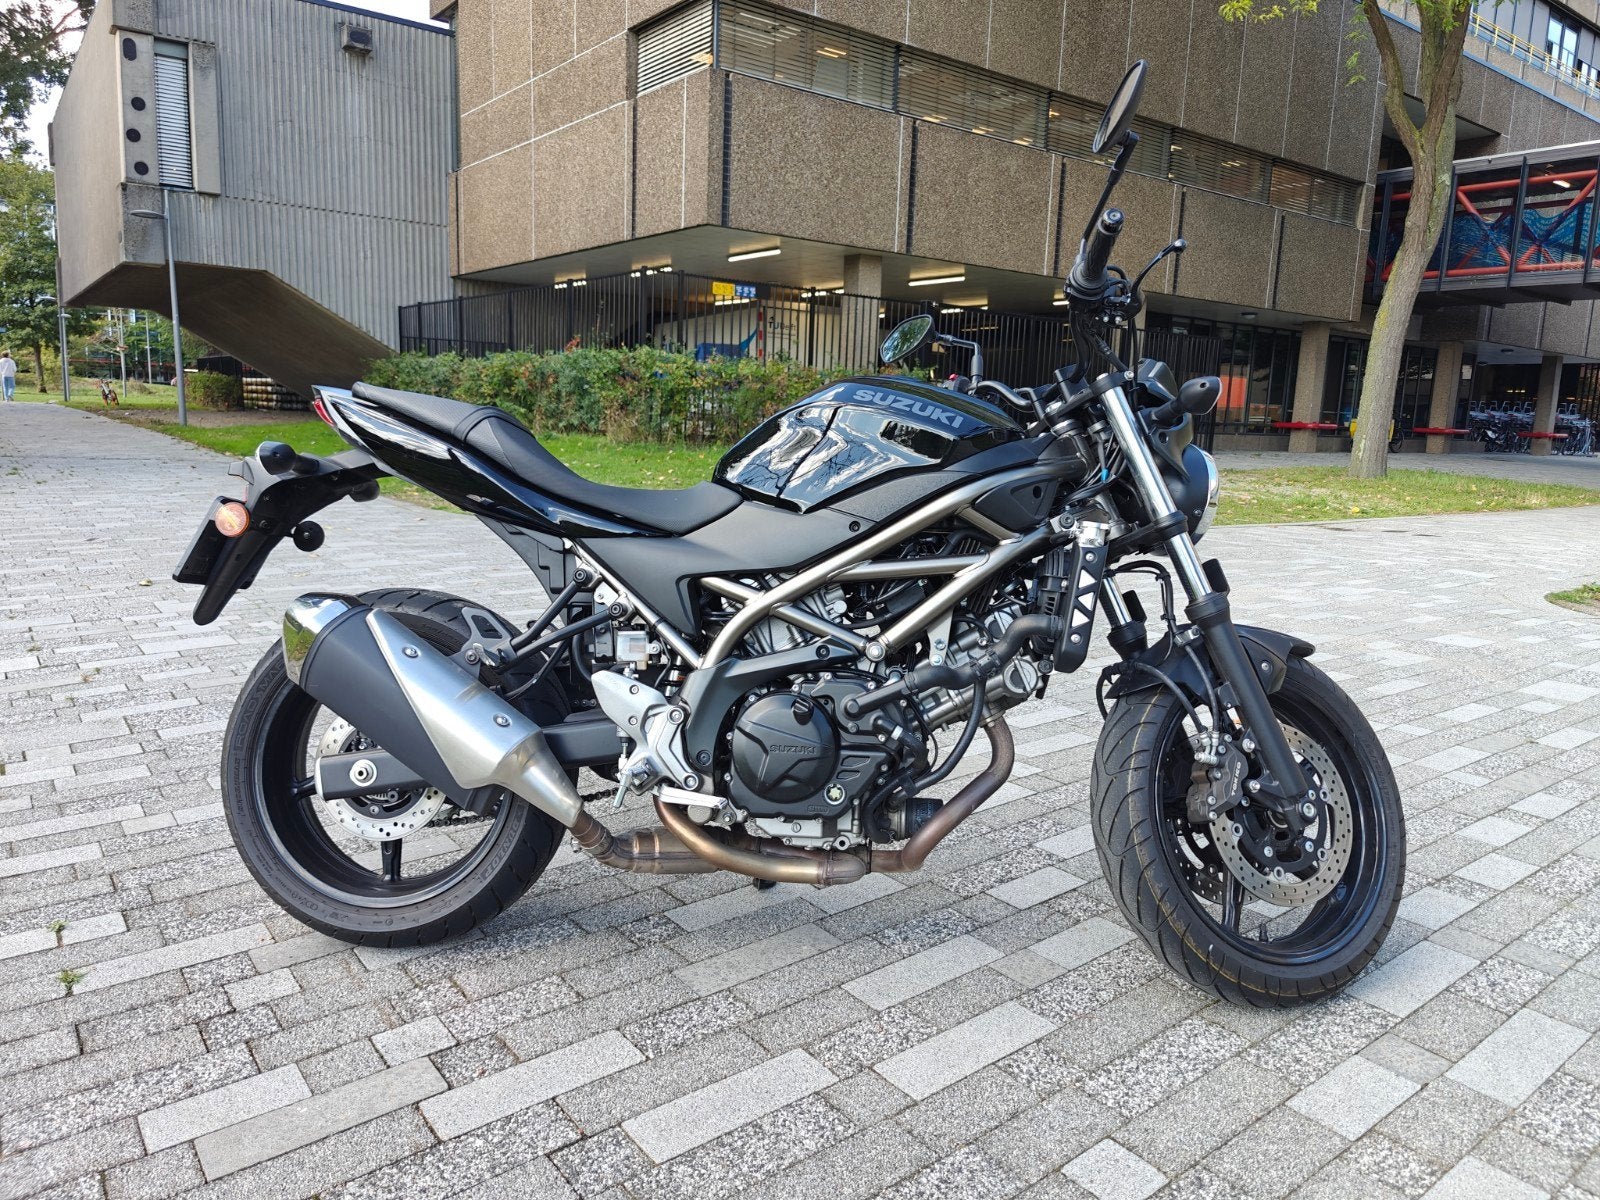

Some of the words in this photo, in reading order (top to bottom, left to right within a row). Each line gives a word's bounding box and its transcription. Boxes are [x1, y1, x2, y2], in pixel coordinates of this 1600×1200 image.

[852, 389, 964, 429] SUZUKI
[235, 660, 284, 750] ROADSMAR
[769, 744, 817, 754] SUZUKI
[1231, 761, 1241, 796] TOKICO
